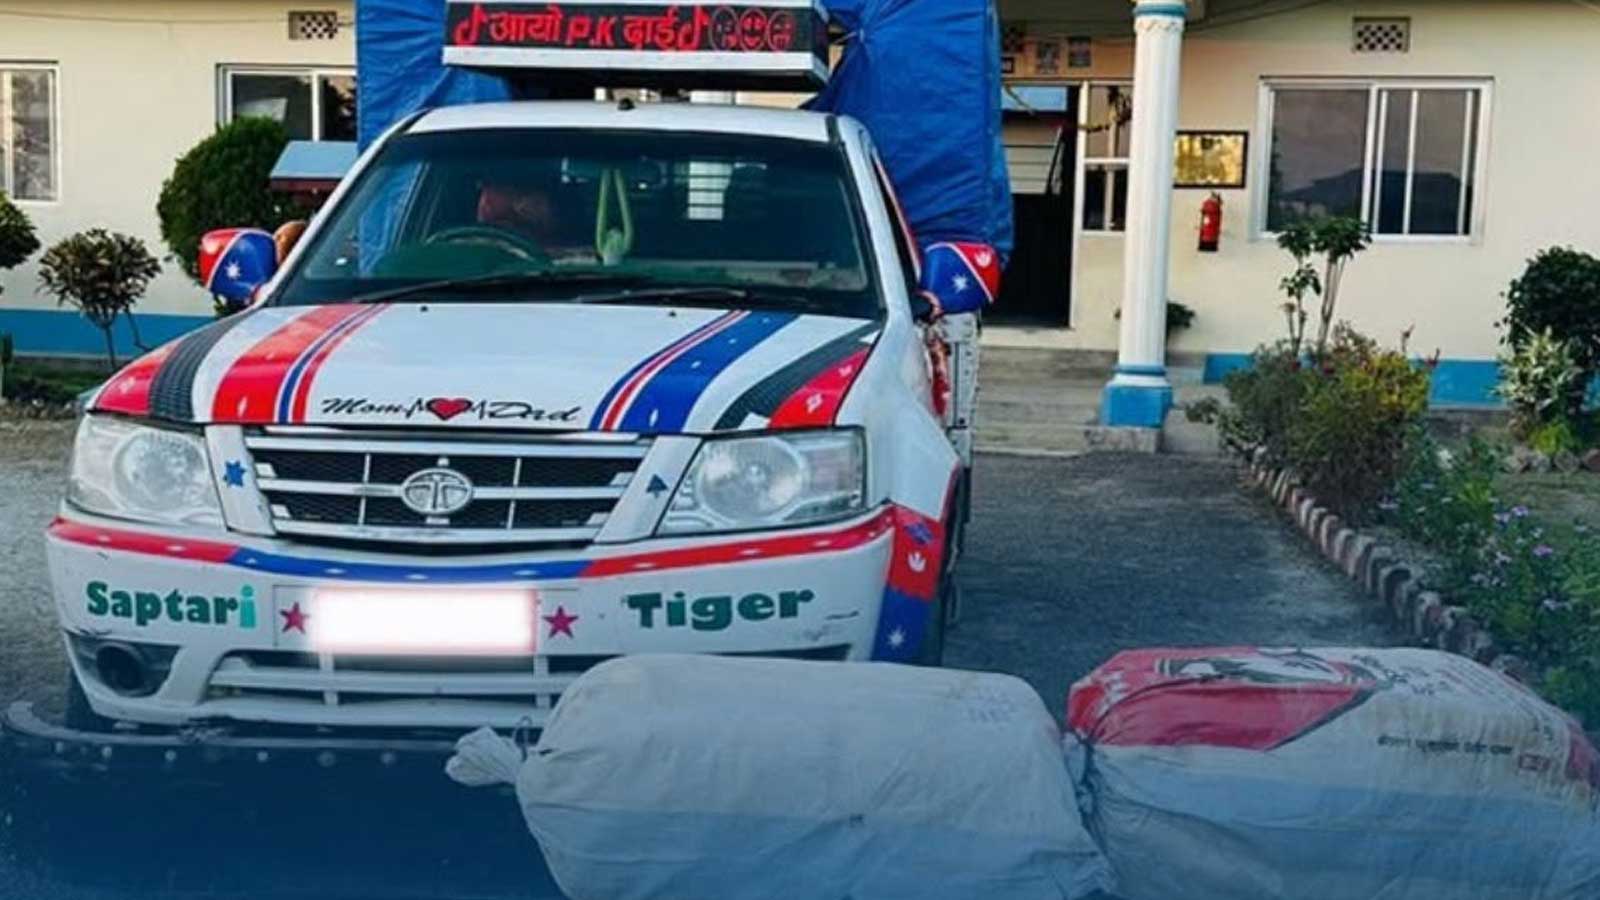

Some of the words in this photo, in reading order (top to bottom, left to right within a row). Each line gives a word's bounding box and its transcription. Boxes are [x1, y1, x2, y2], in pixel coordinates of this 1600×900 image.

[489, 4, 563, 43] आयो
[623, 6, 680, 51] दाई
[321, 397, 406, 415] Mom
[486, 401, 582, 422] Dad
[86, 580, 258, 629] Saptari
[624, 589, 815, 632] Tiger
